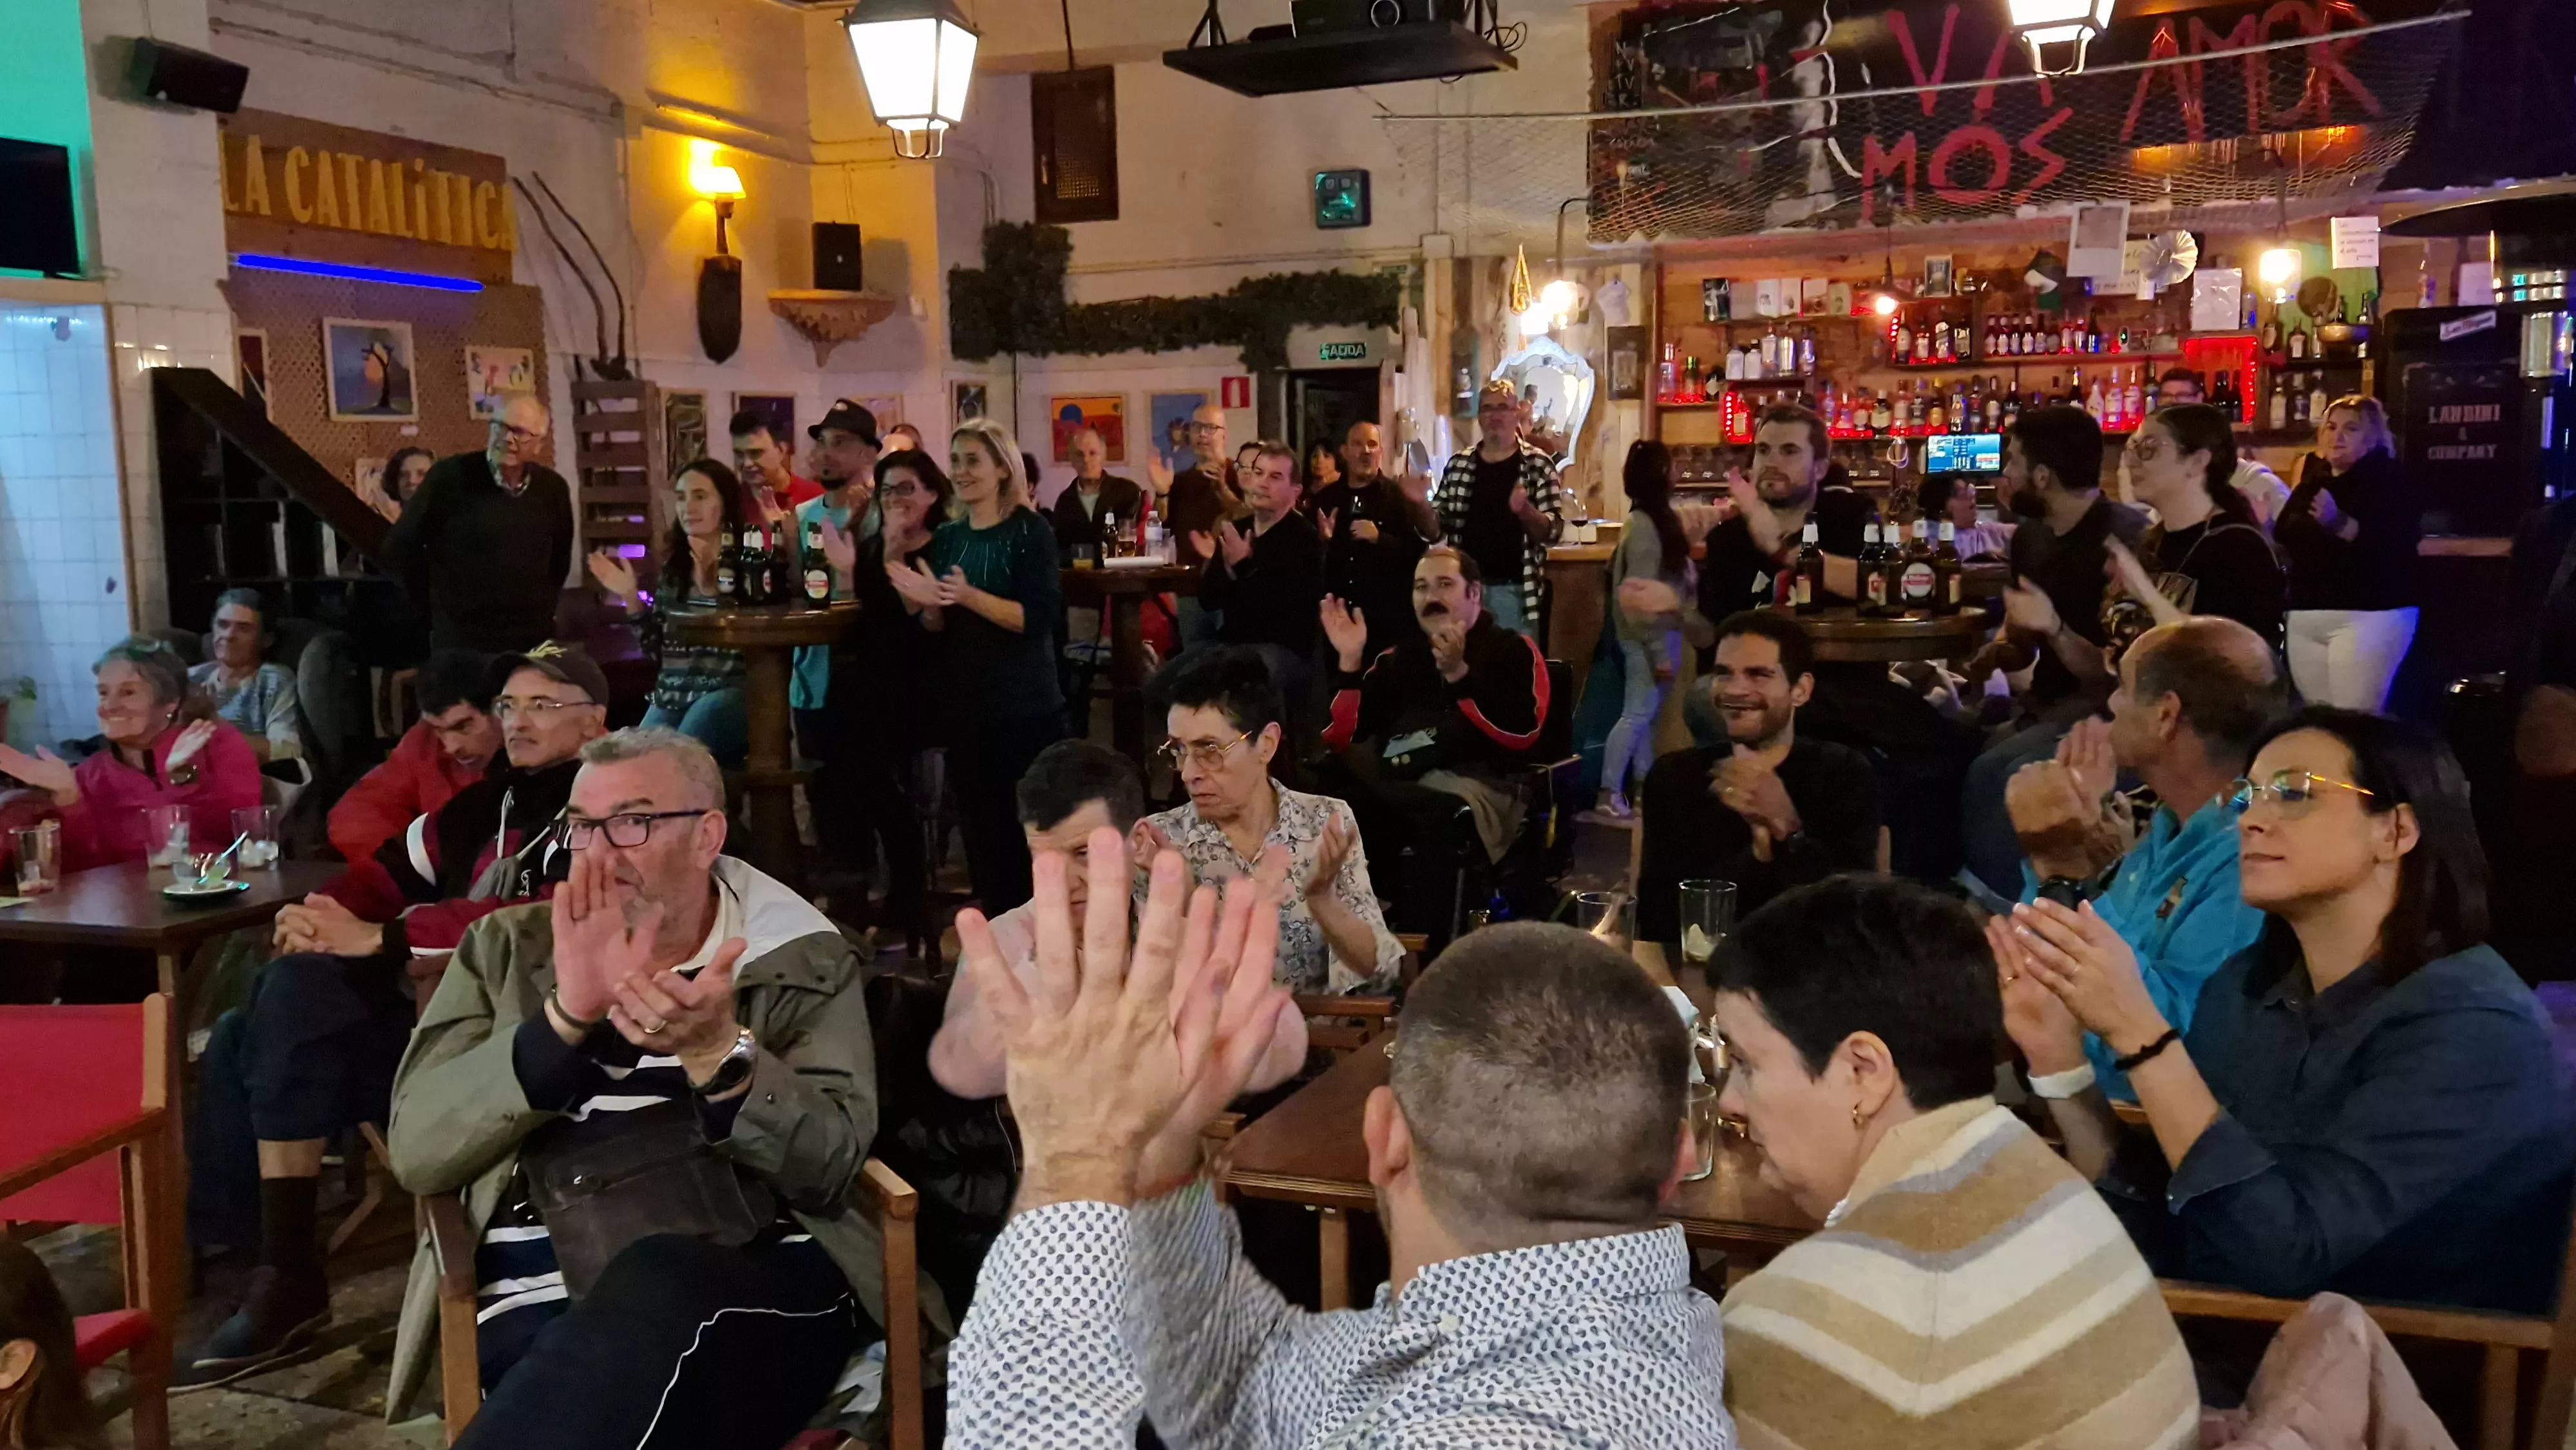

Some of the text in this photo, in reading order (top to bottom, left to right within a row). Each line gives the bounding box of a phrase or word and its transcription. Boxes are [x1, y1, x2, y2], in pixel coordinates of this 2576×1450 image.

[2119, 1, 2384, 143] AMOR
[220, 129, 272, 216] LA
[1861, 106, 2074, 221] MOS
